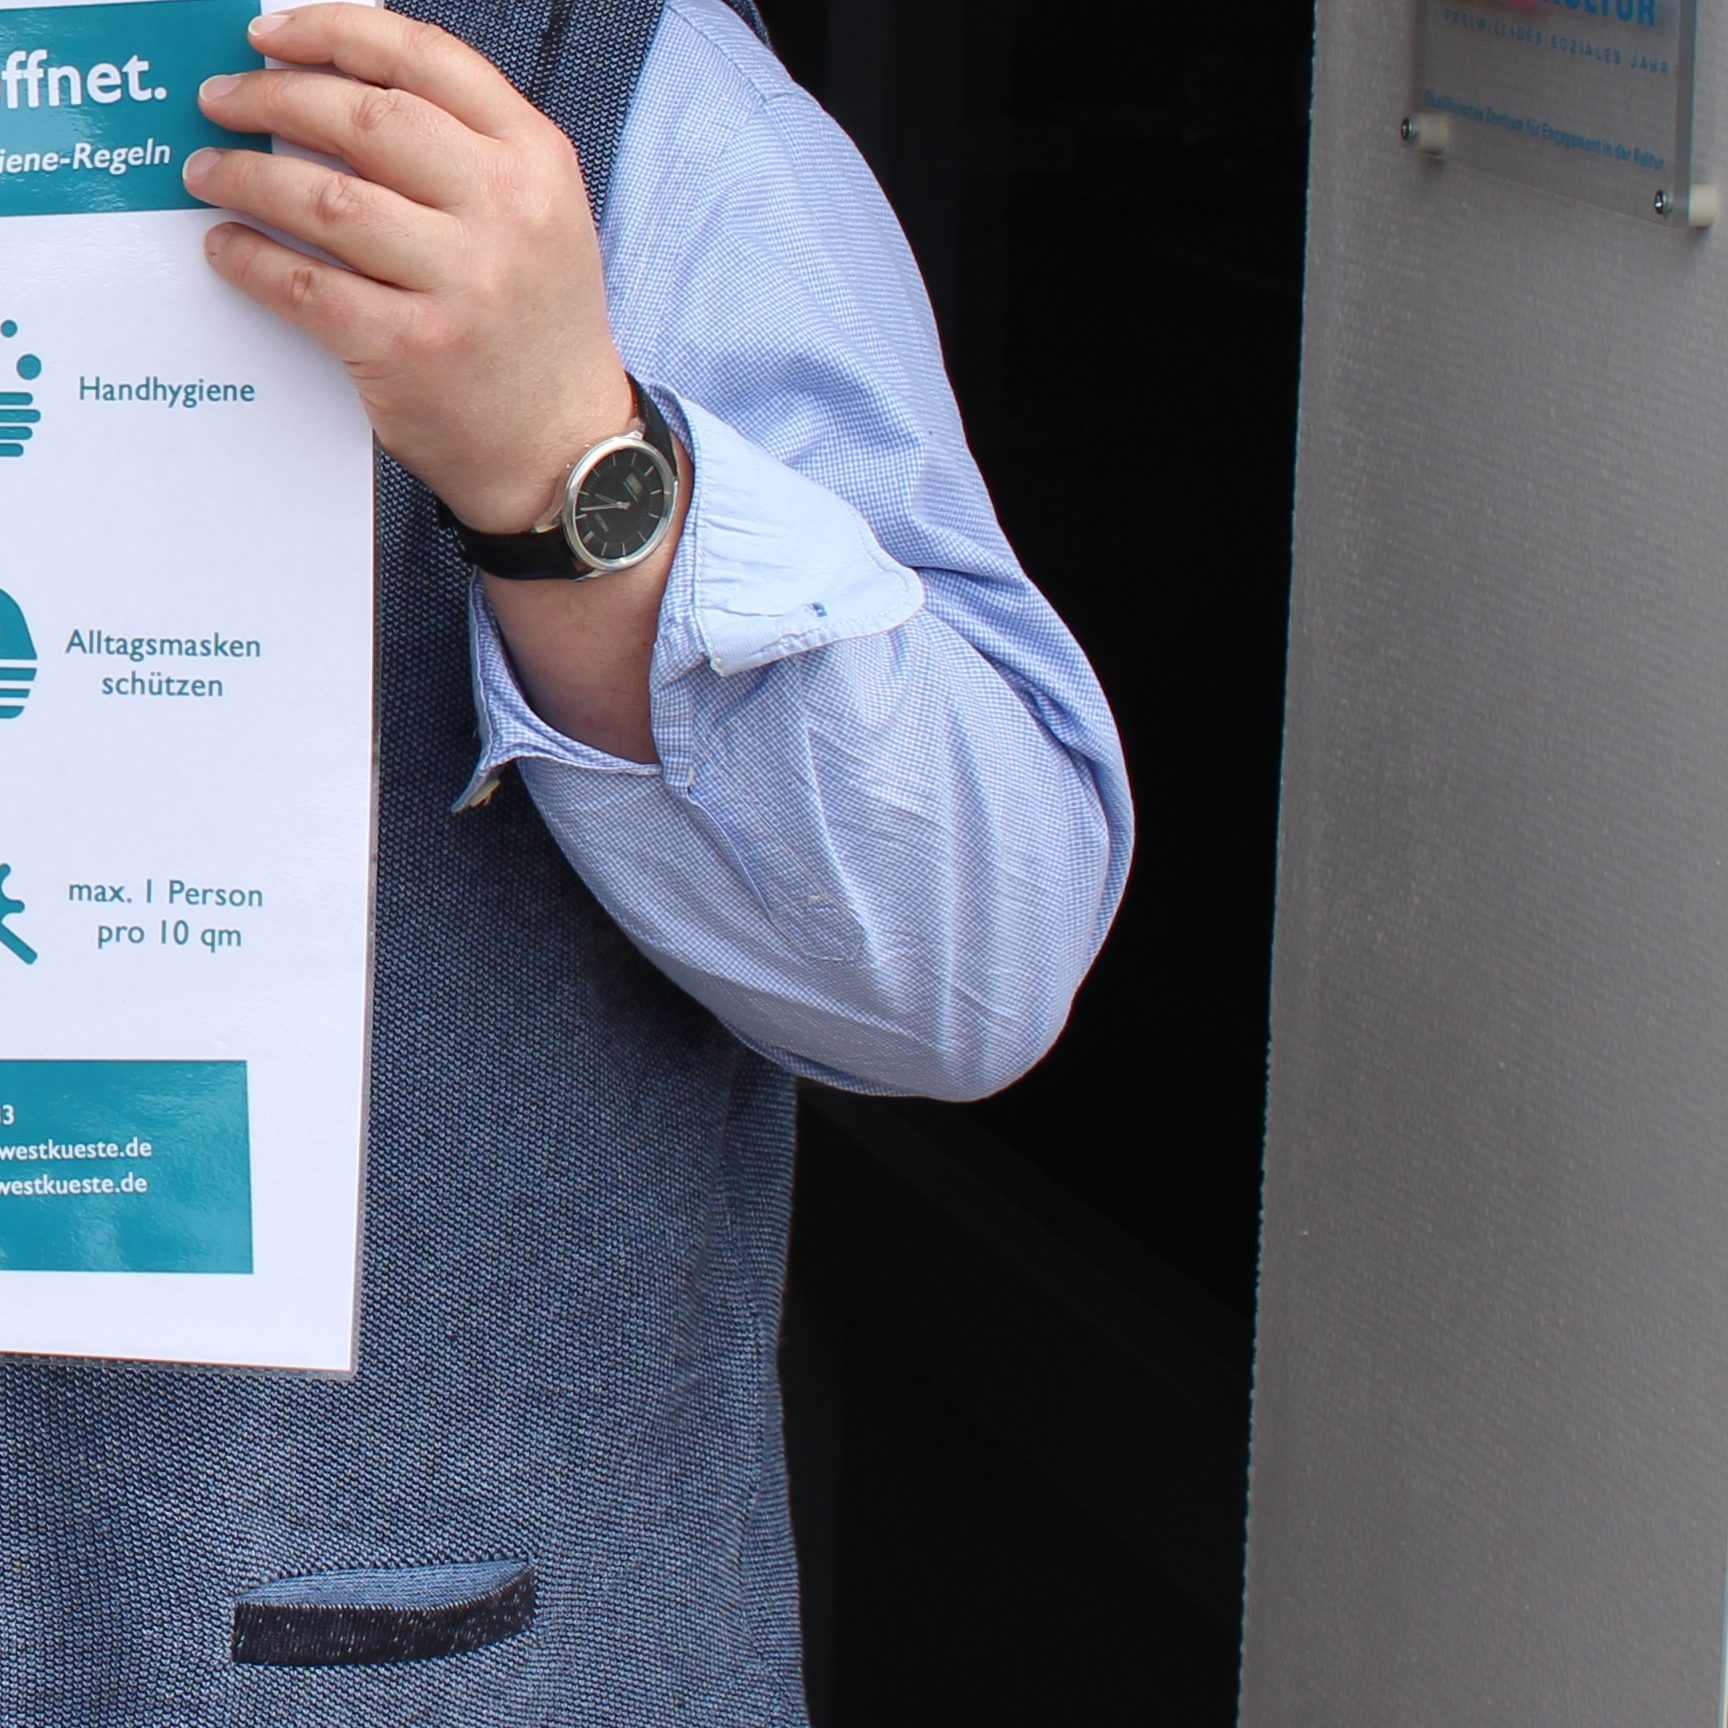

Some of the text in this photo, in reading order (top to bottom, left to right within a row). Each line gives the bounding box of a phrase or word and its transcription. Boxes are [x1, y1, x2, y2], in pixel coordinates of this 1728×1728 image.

[80, 377, 254, 408] Handhygiene
[66, 629, 260, 662] Alltagsmasken
[103, 671, 222, 696] schützen
[69, 884, 131, 903] max.
[169, 880, 262, 906] Person
[98, 920, 241, 953] pro 10 qm
